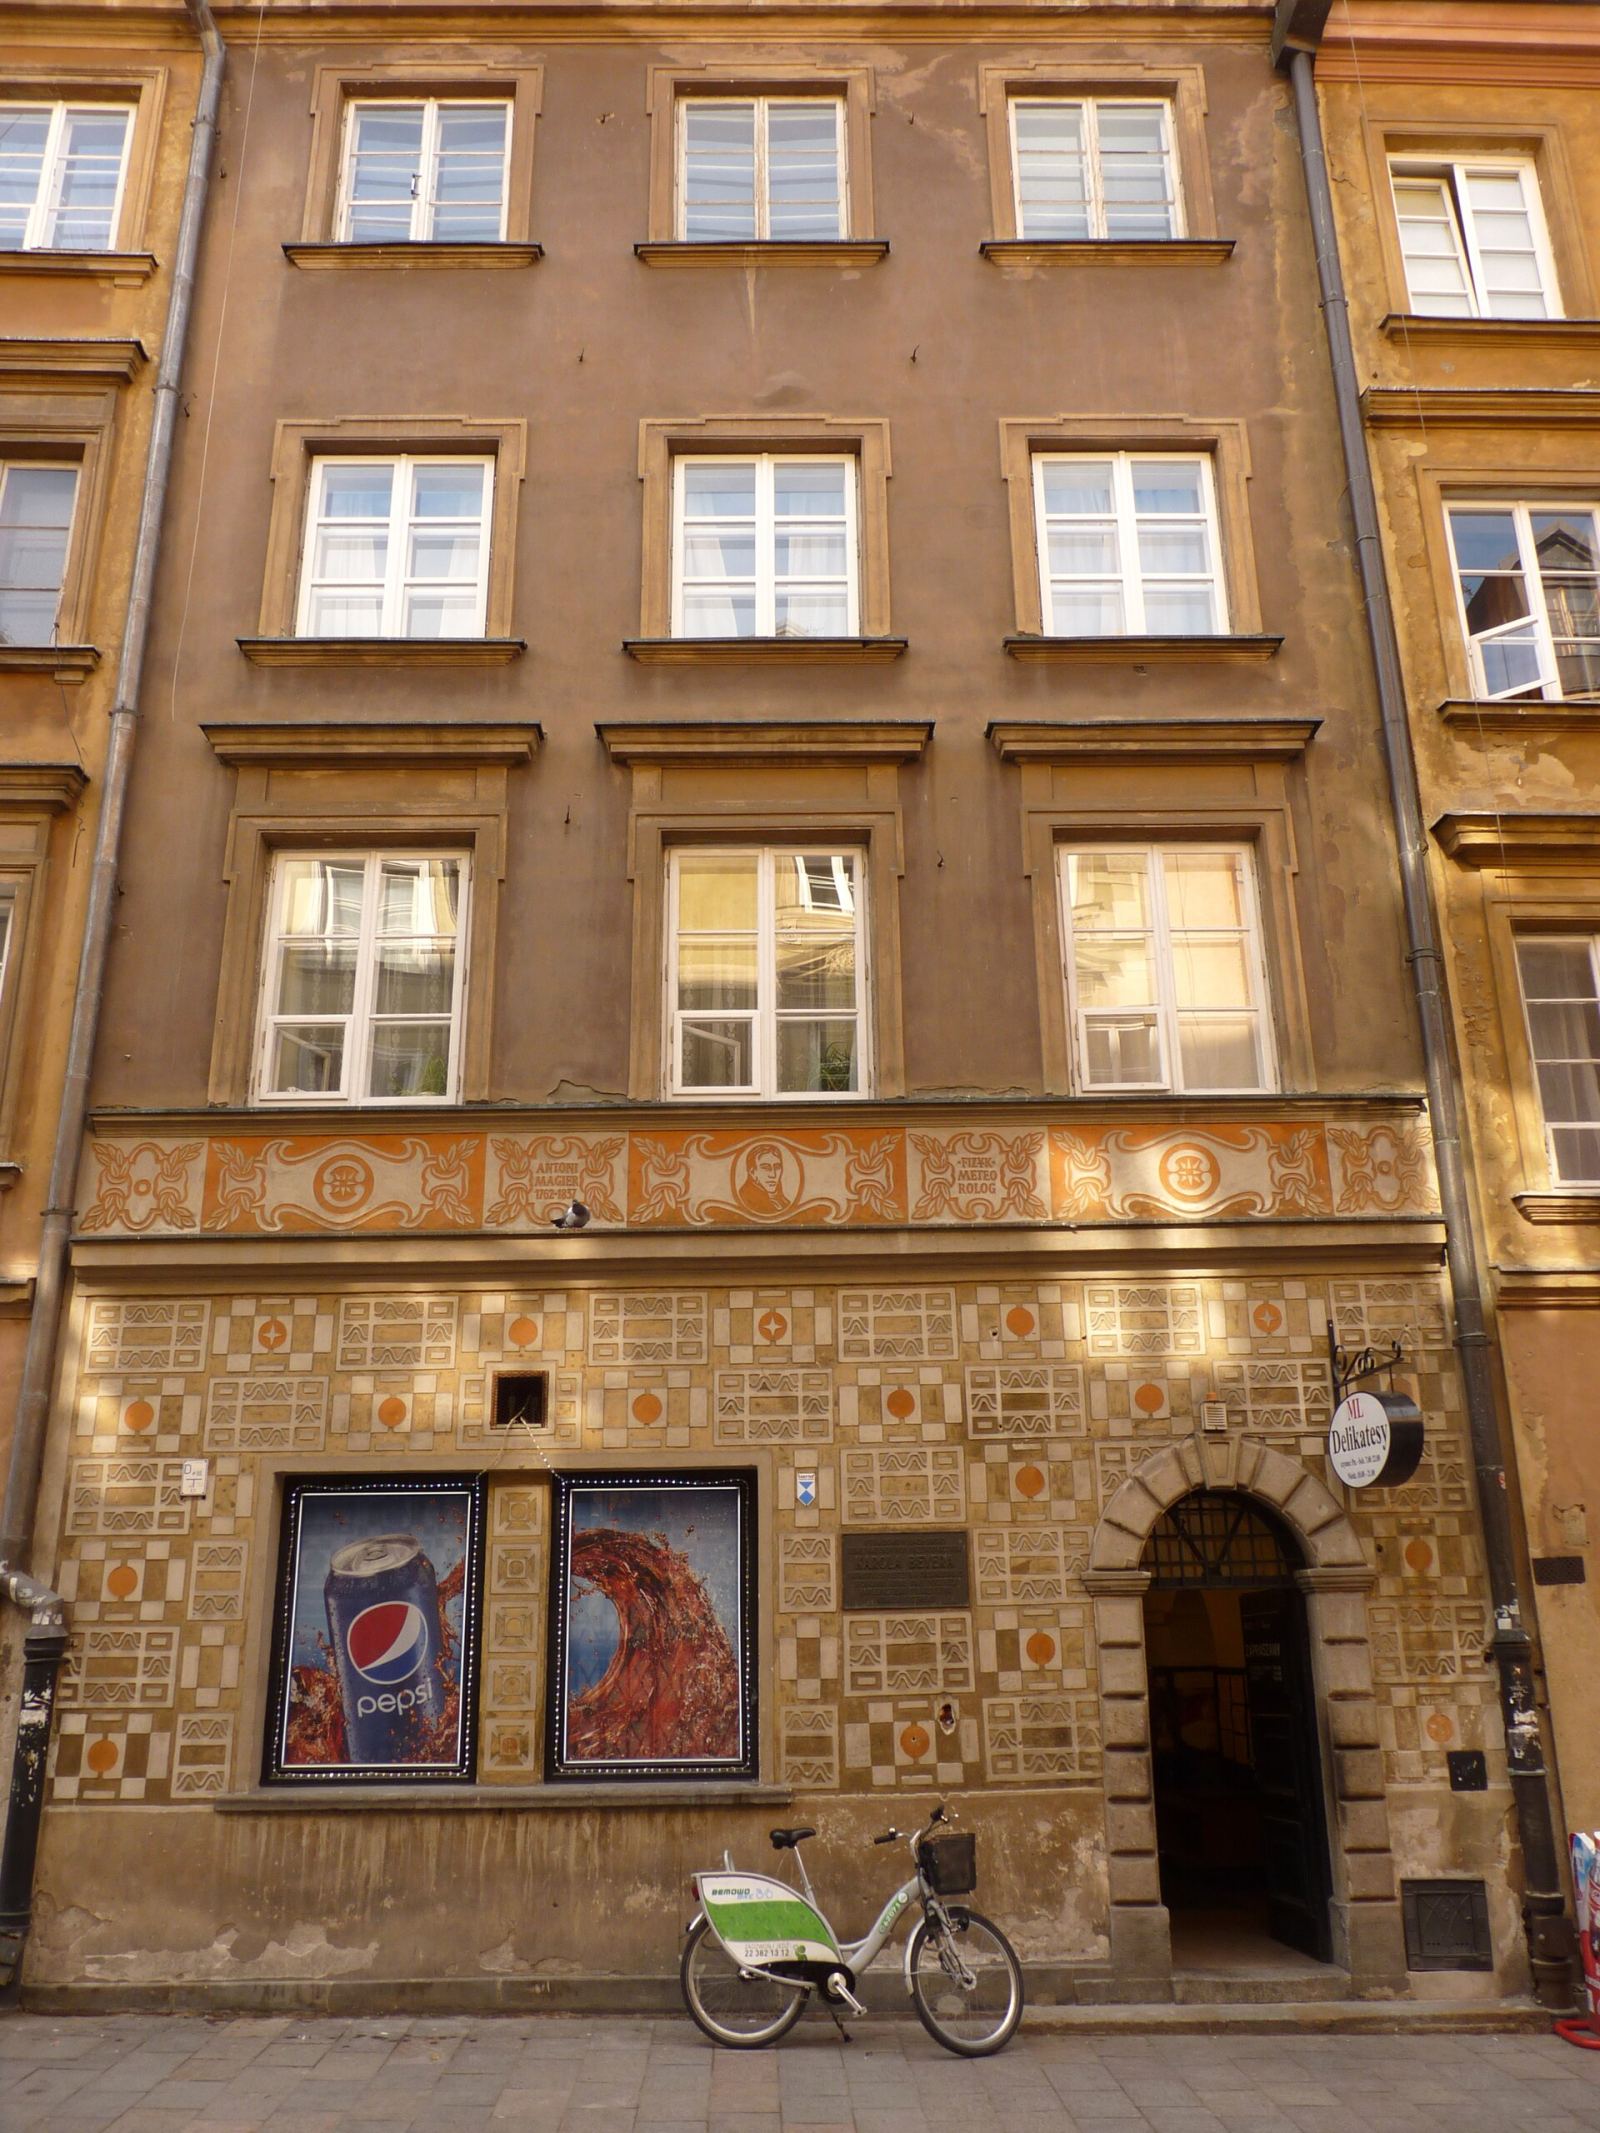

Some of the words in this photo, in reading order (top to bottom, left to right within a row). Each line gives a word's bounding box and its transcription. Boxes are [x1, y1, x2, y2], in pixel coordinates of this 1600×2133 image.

[536, 1163, 578, 1173] ANTONI
[958, 1170, 998, 1180] METEO
[535, 1176, 579, 1186] MAGIER
[958, 1183, 996, 1194] ROLOG
[535, 1189, 577, 1199] 1762-1837
[1347, 1398, 1364, 1420] ML
[1331, 1424, 1388, 1454] Delikatesy
[357, 1677, 432, 1718] pepsi
[711, 1888, 751, 1897] BEMOWO
